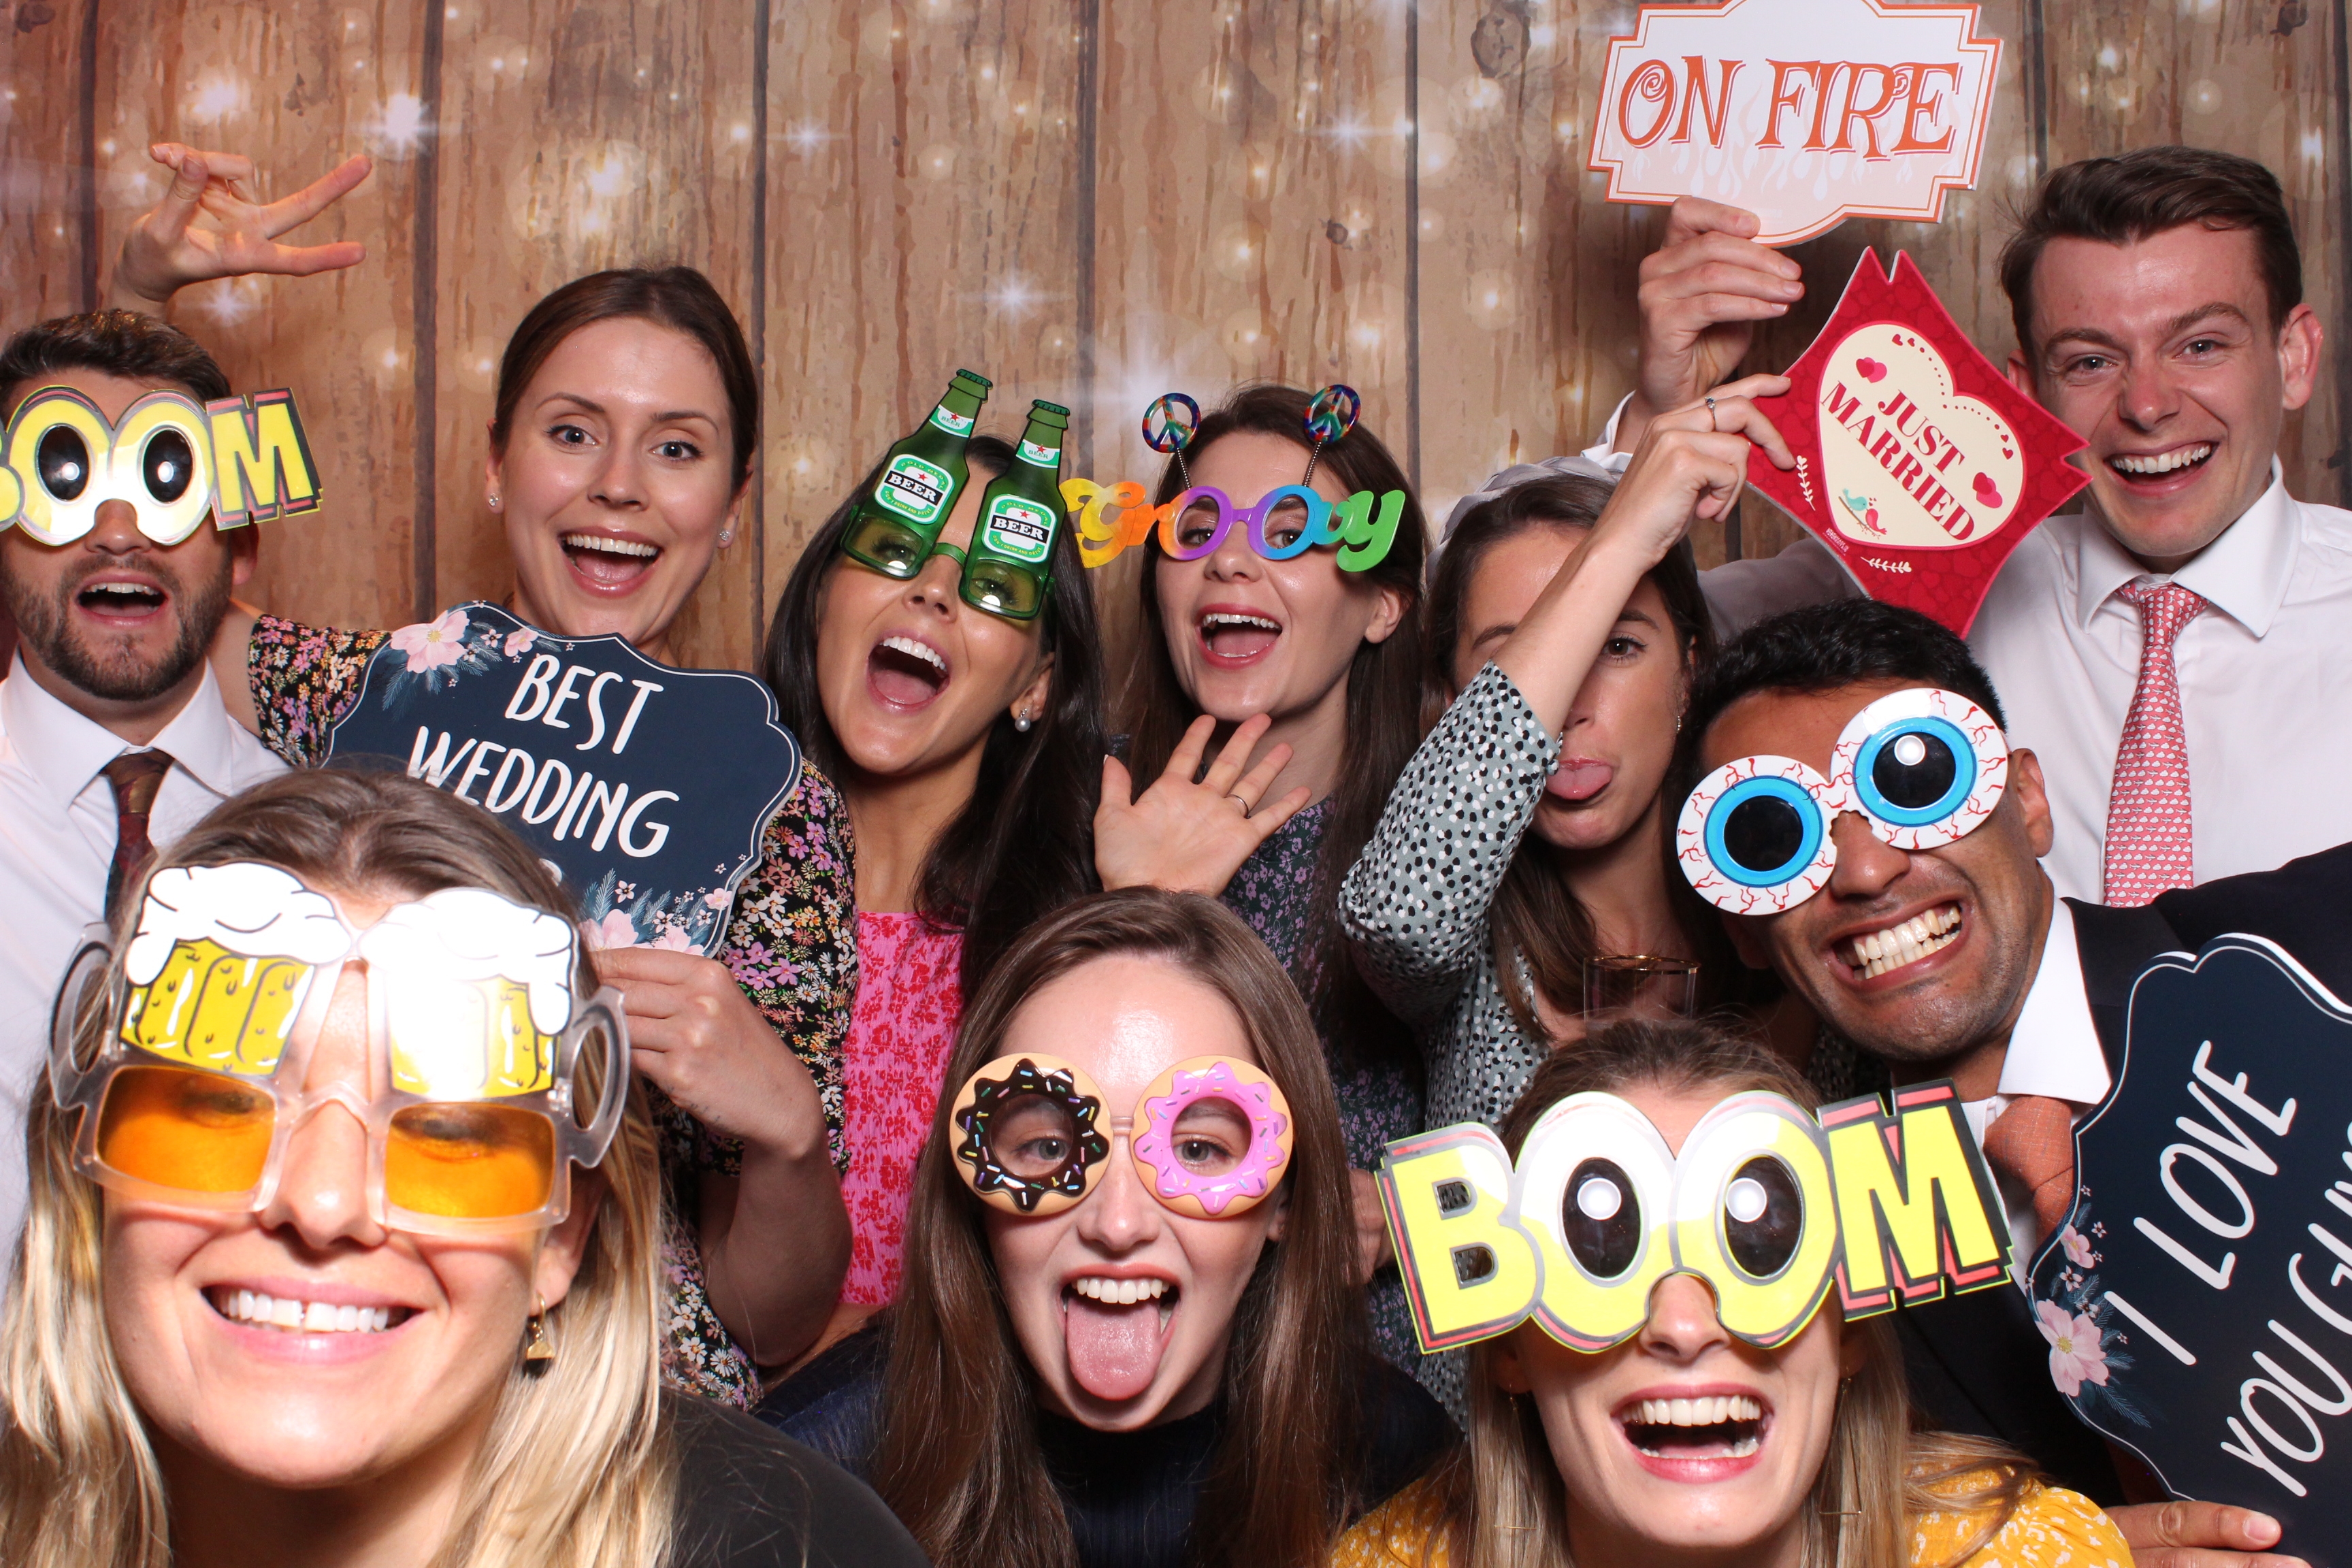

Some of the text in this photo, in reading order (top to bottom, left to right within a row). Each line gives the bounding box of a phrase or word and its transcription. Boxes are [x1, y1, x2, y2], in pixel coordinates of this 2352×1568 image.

[1618, 54, 1961, 163] ON FIRE
[941, 416, 961, 427] BEER
[1028, 450, 1049, 459] BEER
[1819, 380, 1976, 542] MARRIED
[1878, 390, 1966, 475] JUST
[888, 473, 937, 502] BEER
[894, 501, 907, 510] DRINK
[917, 507, 932, 516] DRIVE
[993, 517, 1044, 540] BEER
[1059, 478, 1406, 573] Groovy
[1004, 544, 1018, 553] DRINK
[1028, 546, 1043, 556] DRIVE
[504, 653, 664, 755] BEST
[407, 725, 680, 858] WEDDING
[1374, 1078, 2014, 1354] BOOM
[2104, 1040, 2297, 1366] I LOVE
[2227, 1319, 2352, 1497] YOU
